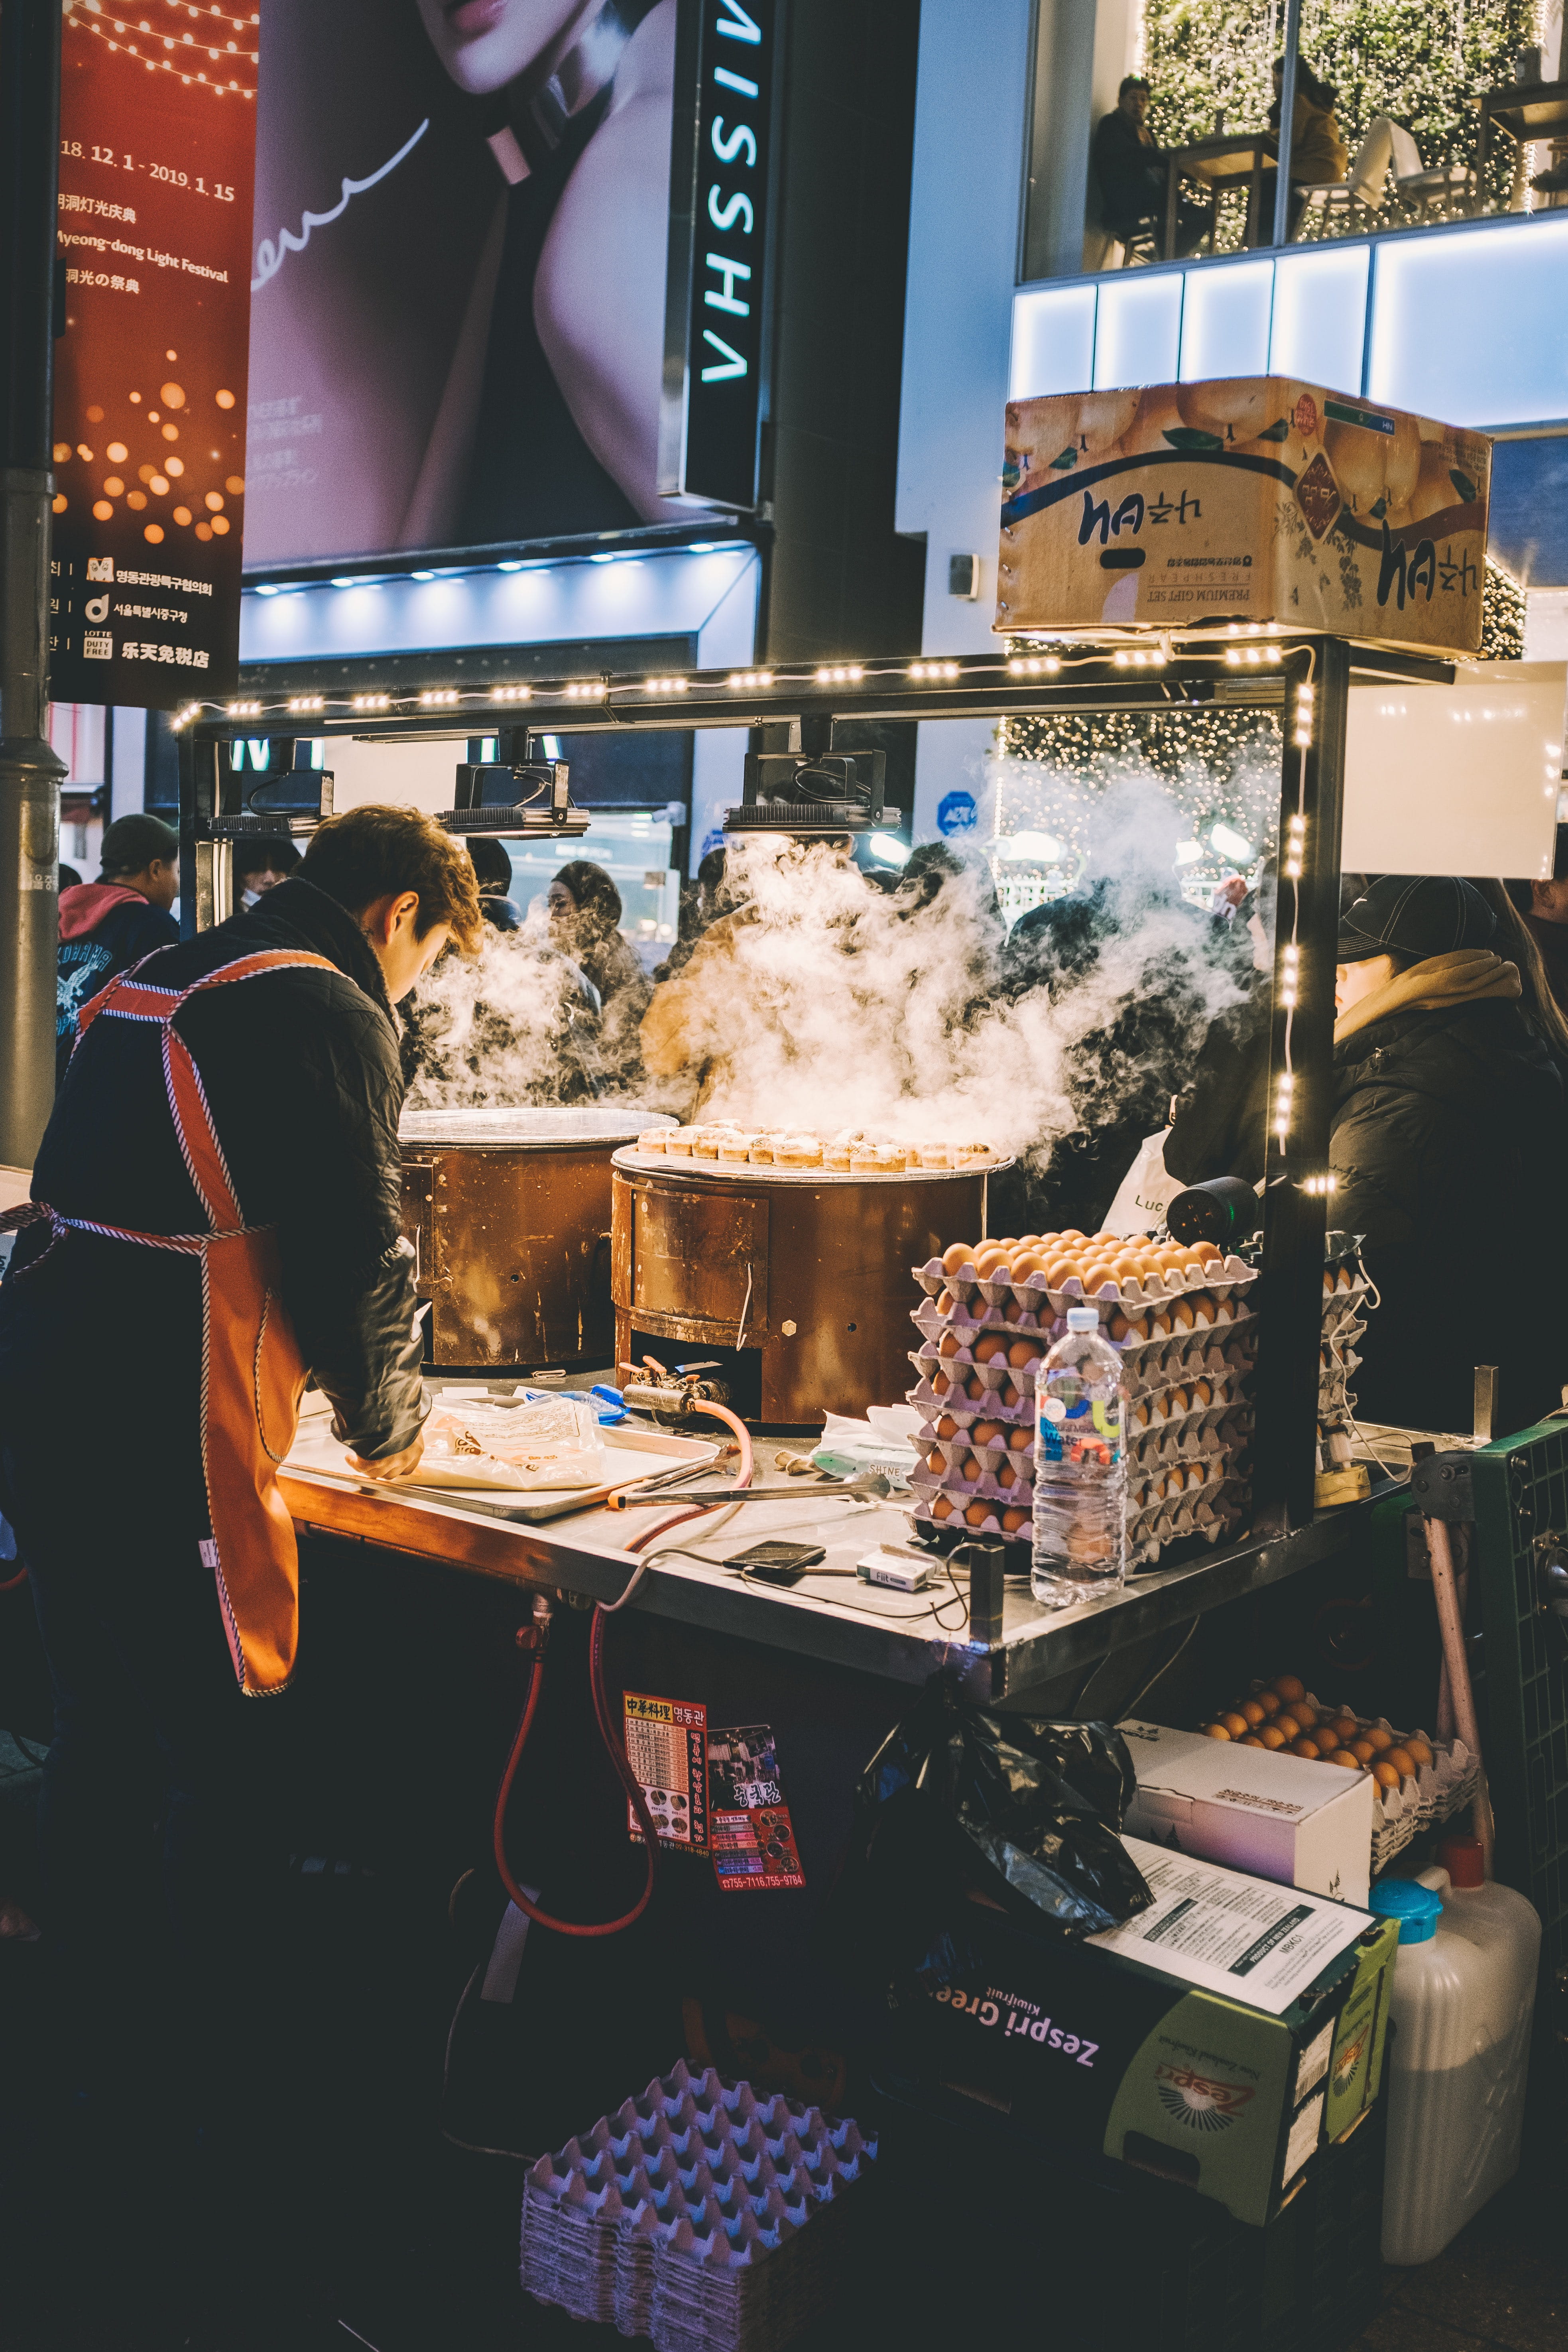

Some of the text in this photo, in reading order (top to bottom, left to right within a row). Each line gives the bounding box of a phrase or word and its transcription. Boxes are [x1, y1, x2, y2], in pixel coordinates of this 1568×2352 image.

[91, 146, 117, 167] 12.
[150, 163, 191, 189] 2019.
[195, 178, 209, 196] 1.
[214, 184, 234, 201] 15
[147, 248, 179, 268] Light
[181, 258, 229, 283] Festival
[116, 570, 212, 596] 명동관광특구협의회
[1147, 589, 1250, 602] PREMIUM GIFT SET
[114, 604, 187, 623] 서울특별시중구청
[122, 642, 210, 668] 乐天免税店
[1045, 1431, 1081, 1446] Water
[870, 1464, 900, 1476] SHINE
[627, 1698, 671, 1720] 中華料理
[673, 1707, 704, 1726] 명동관
[734, 1781, 781, 1807] 중국관
[675, 1844, 709, 1857] 02-318-4840
[1248, 1944, 1273, 1962] PRODUCT
[1271, 1931, 1285, 1941] NEW
[1279, 1916, 1302, 1933] ZEALAND.
[1277, 1933, 1306, 1954] MBKC1
[986, 1986, 1041, 2017] Kiwifruit
[930, 1984, 1100, 2067] Zespri Gree
[1155, 2061, 1257, 2117] Zespri
